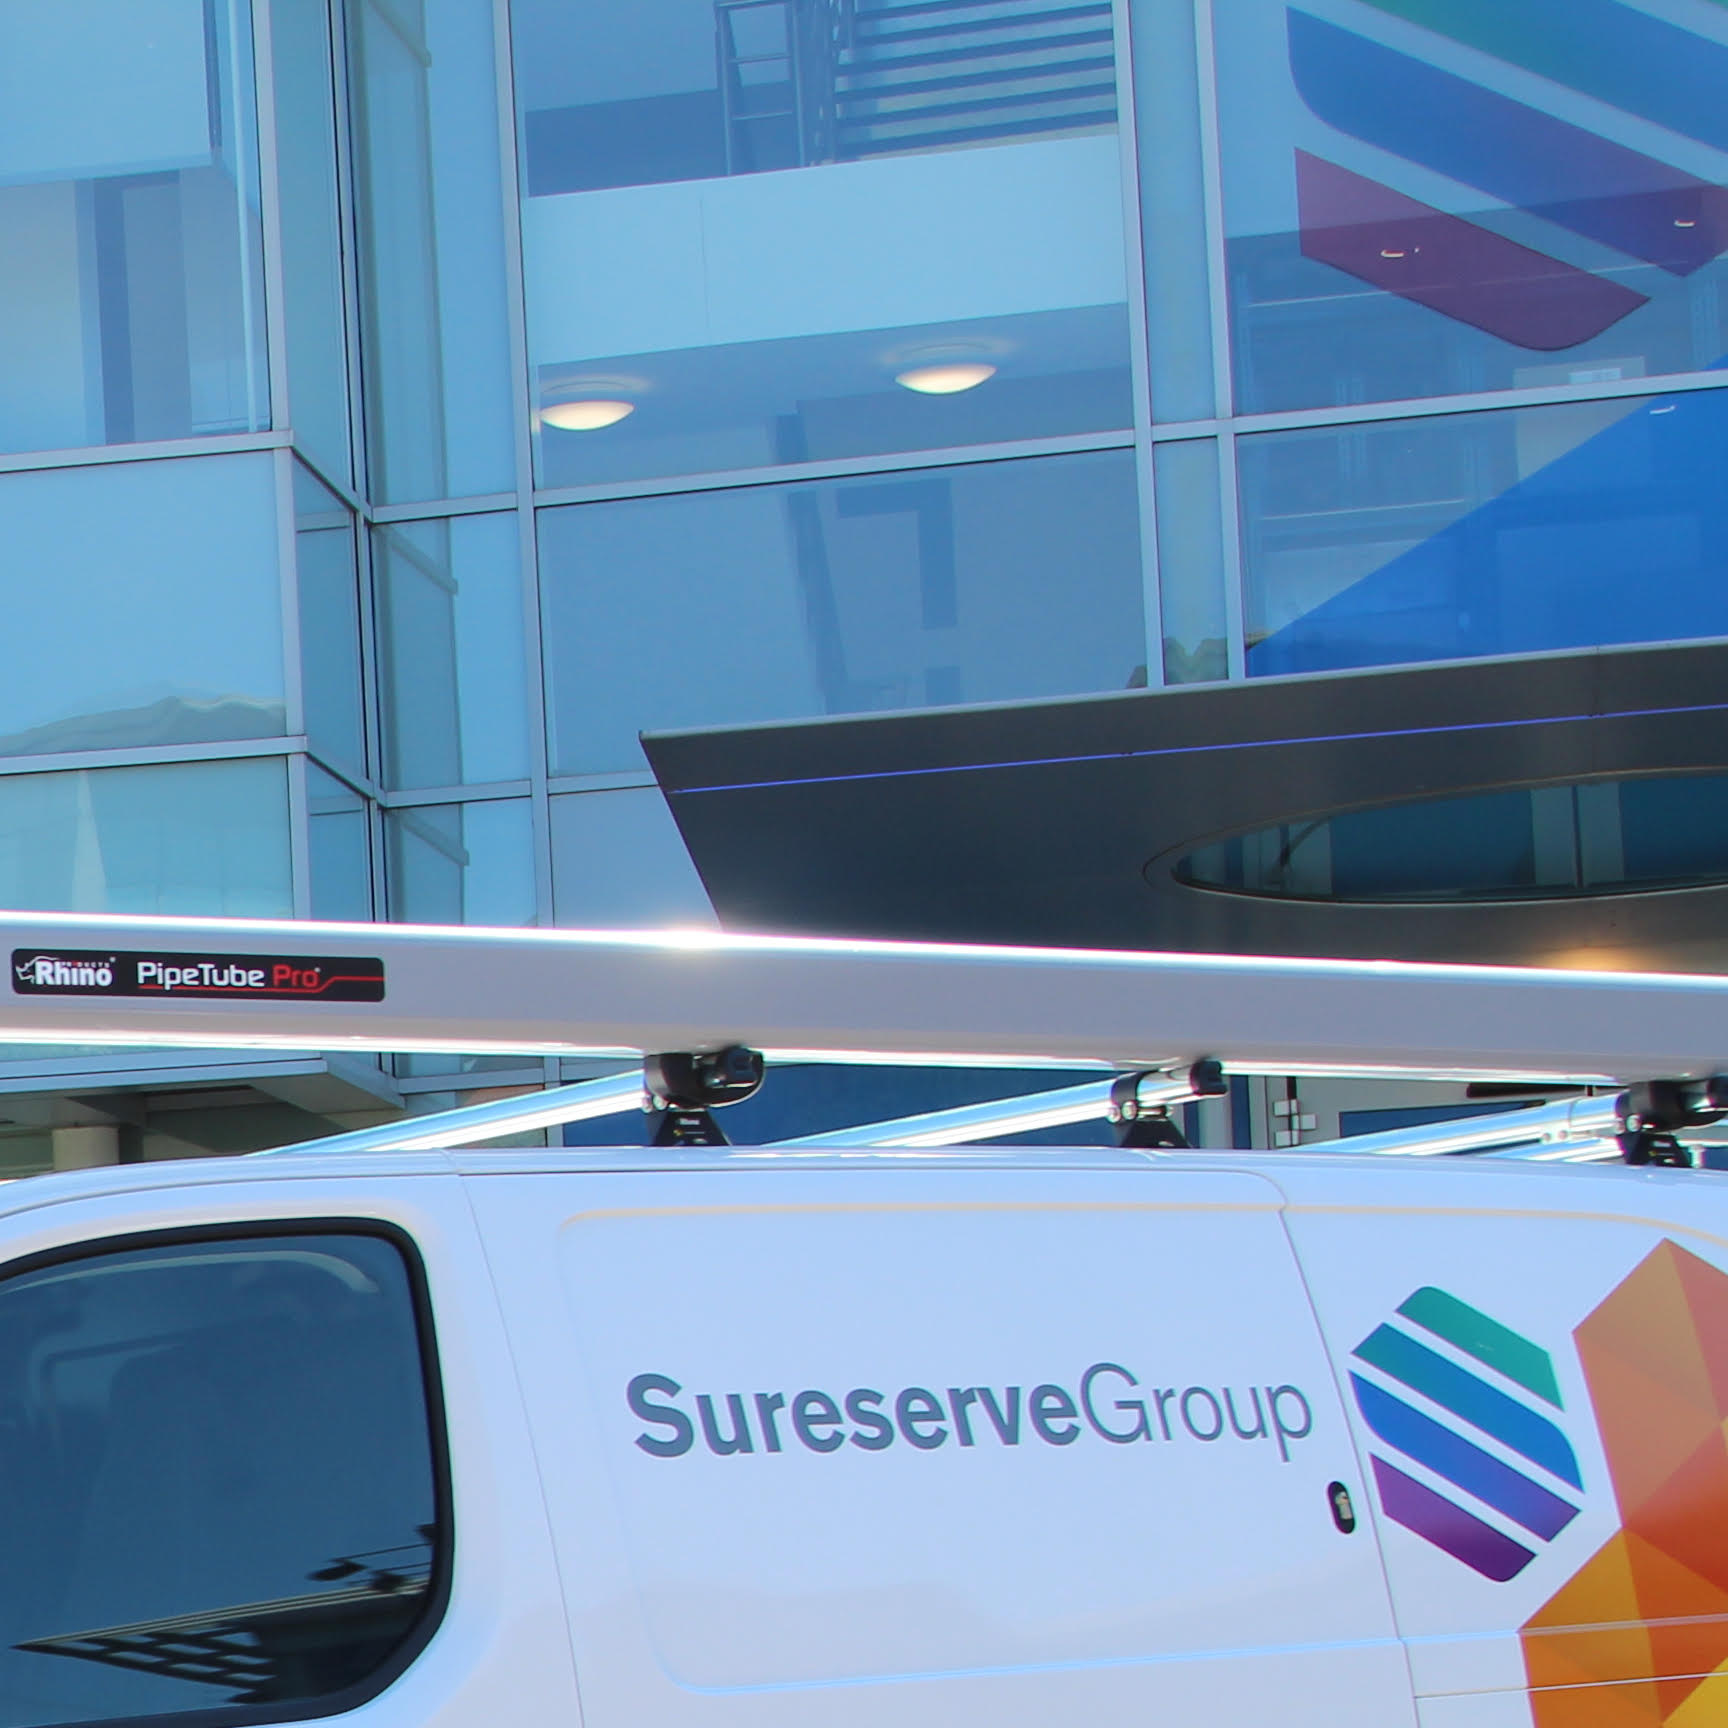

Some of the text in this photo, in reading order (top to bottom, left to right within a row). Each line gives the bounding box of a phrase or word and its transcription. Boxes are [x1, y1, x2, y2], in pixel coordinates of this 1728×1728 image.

[34, 960, 113, 986] Rhino
[136, 961, 321, 990] PipeTube Pro
[626, 1362, 1313, 1463] SureserveGroup
